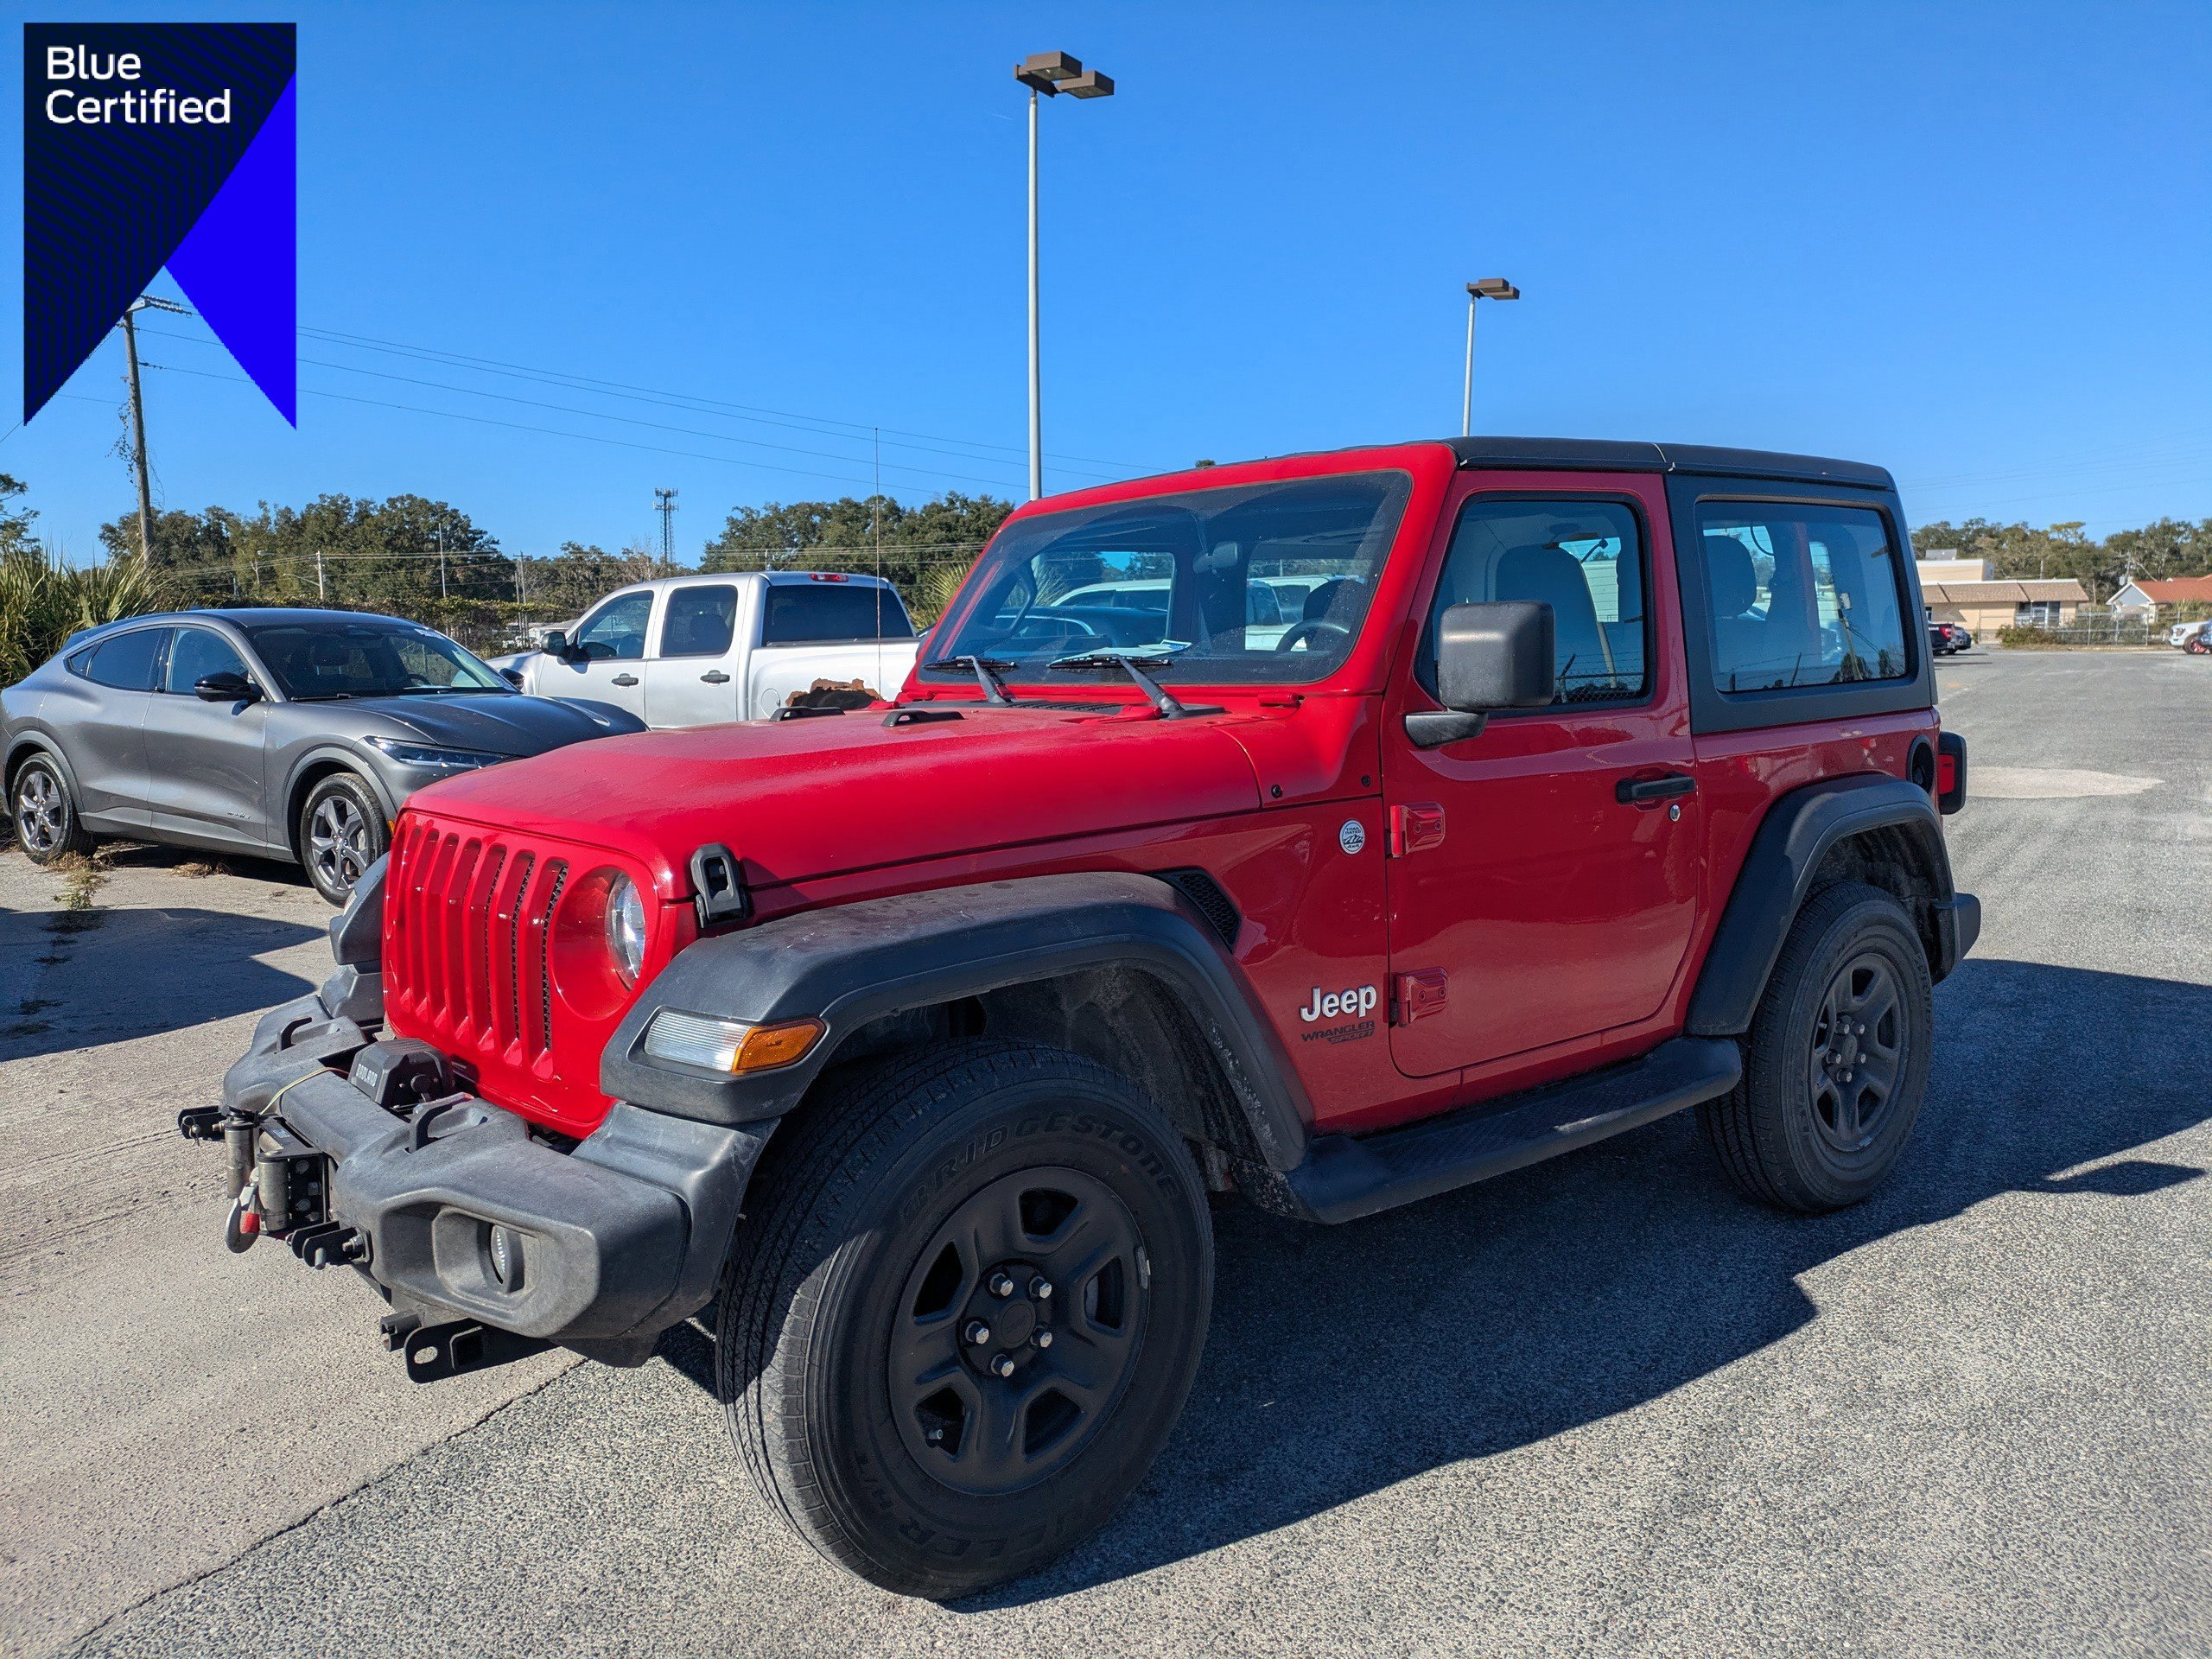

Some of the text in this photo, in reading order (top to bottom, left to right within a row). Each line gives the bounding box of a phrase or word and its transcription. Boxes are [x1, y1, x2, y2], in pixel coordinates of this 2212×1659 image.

[1300, 984, 1377, 1022] Jeep
[1301, 1020, 1376, 1042] WRANGLER
[899, 1109, 1183, 1224] BRIDGESTONE
